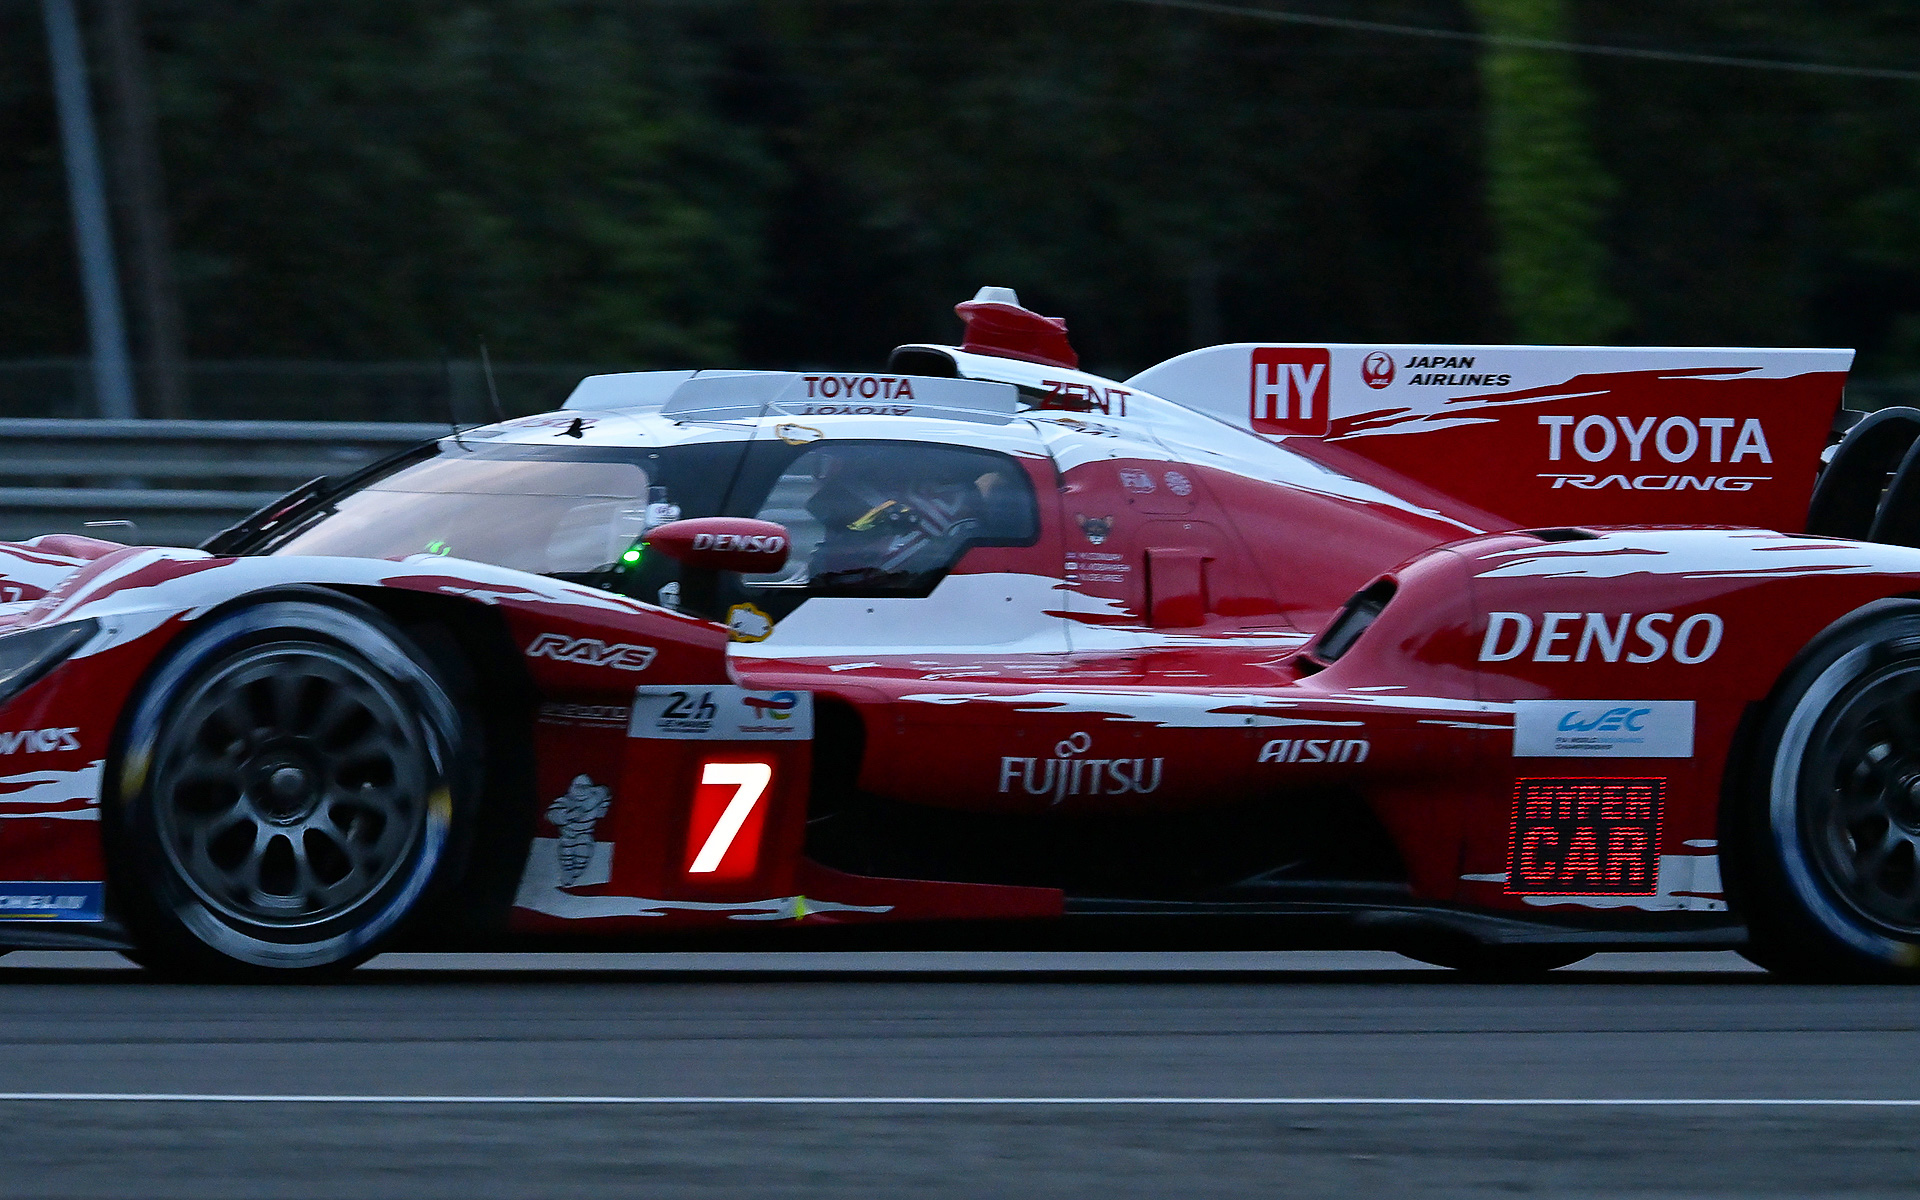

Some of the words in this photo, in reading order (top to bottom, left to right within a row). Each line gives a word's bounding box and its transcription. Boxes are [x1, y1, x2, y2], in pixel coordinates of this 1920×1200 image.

[1404, 356, 1475, 369] JAPAN
[1408, 373, 1512, 387] AIRLINES
[803, 376, 914, 400] TOYOTA
[1041, 379, 1132, 417] ZENT
[1254, 363, 1326, 420] HY
[1539, 415, 1773, 464] TOYOTA
[1536, 474, 1773, 492] RACING
[693, 533, 785, 554] DENSO
[525, 633, 658, 671] RAYS
[1479, 611, 1724, 665] DENSO
[1557, 707, 1652, 732] WEC
[1257, 739, 1370, 763] AISIN
[999, 745, 1164, 805] FUJITSU
[689, 763, 772, 874] 7
[1526, 786, 1653, 820] HYPER
[1519, 827, 1649, 886] CAR
